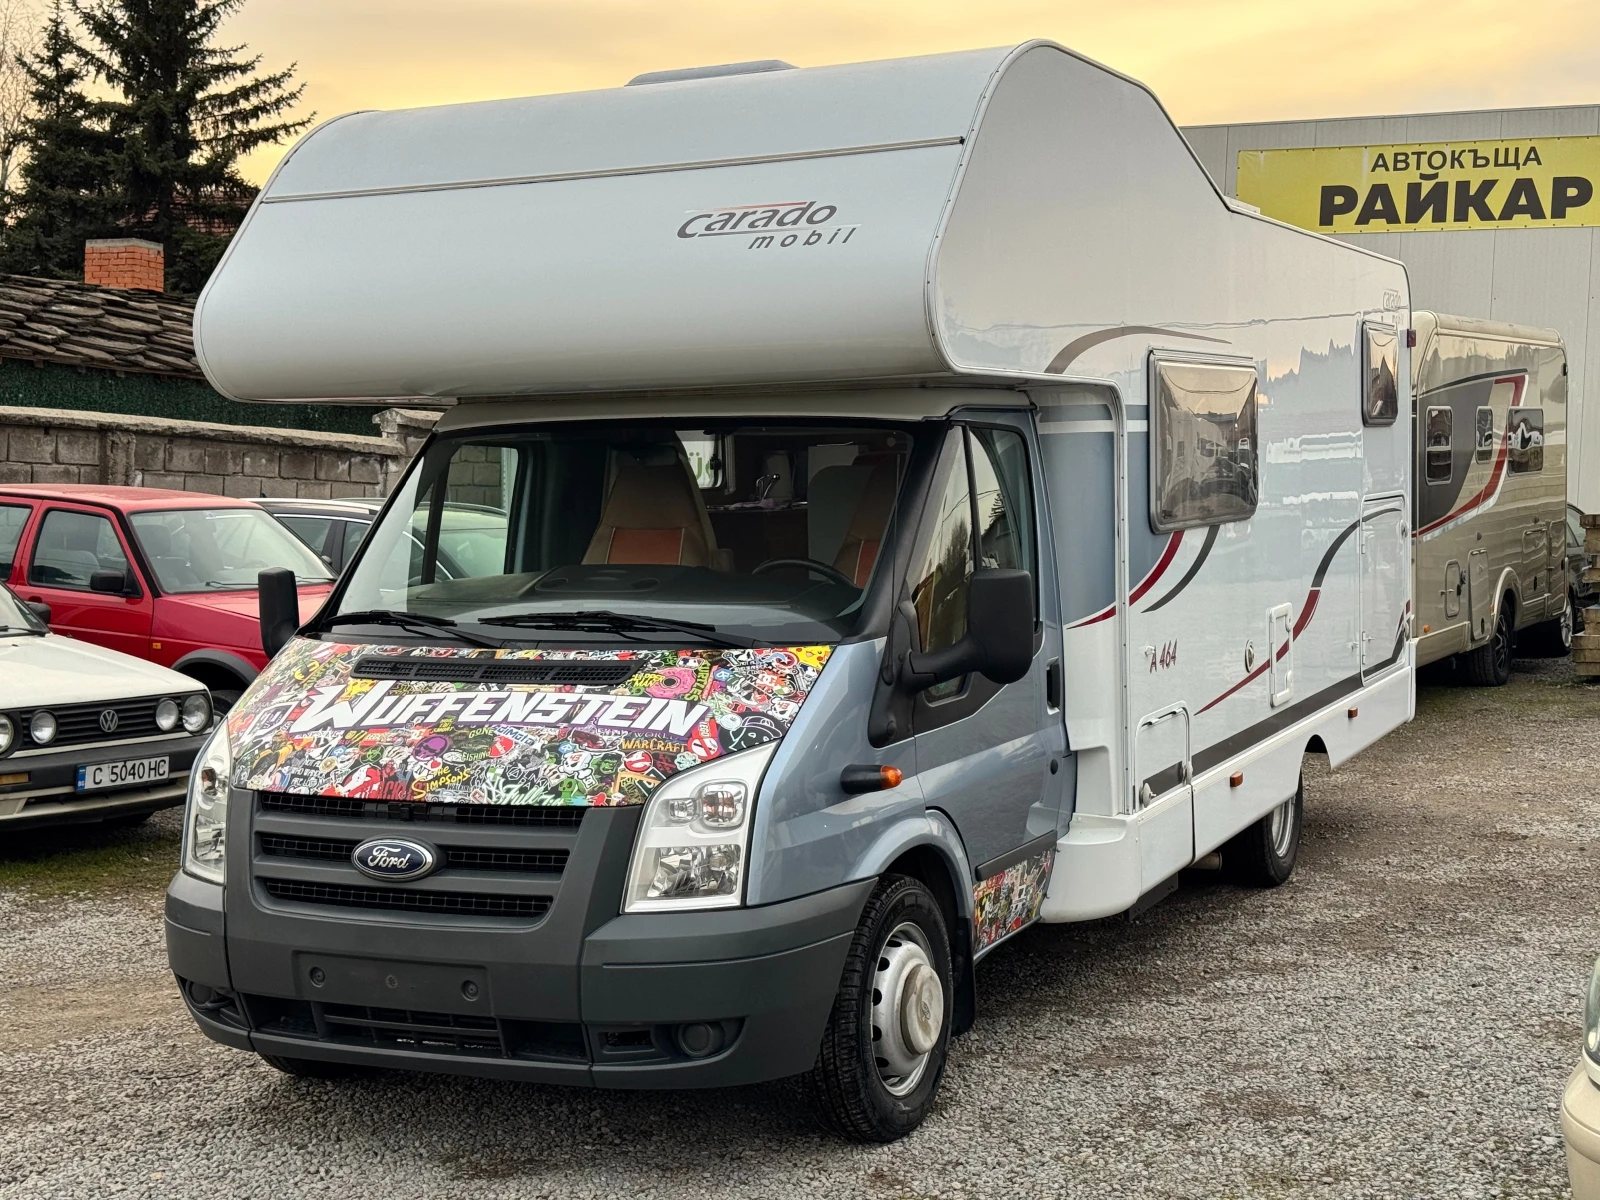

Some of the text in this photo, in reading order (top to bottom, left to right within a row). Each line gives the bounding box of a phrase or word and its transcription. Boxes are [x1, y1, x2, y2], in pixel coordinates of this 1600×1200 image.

[1371, 146, 1542, 172] АВТОКЪЩА
[1319, 172, 1593, 226] РАЙКАР
[677, 200, 838, 239] carado
[748, 228, 857, 250] mobil
[1149, 638, 1178, 674] A 464
[289, 679, 710, 737] WUFFENSTEIN
[469, 727, 494, 738] GONE
[621, 737, 688, 753] WARCRAFT
[93, 759, 166, 785] C 5040 HC
[367, 846, 411, 869] Ford
